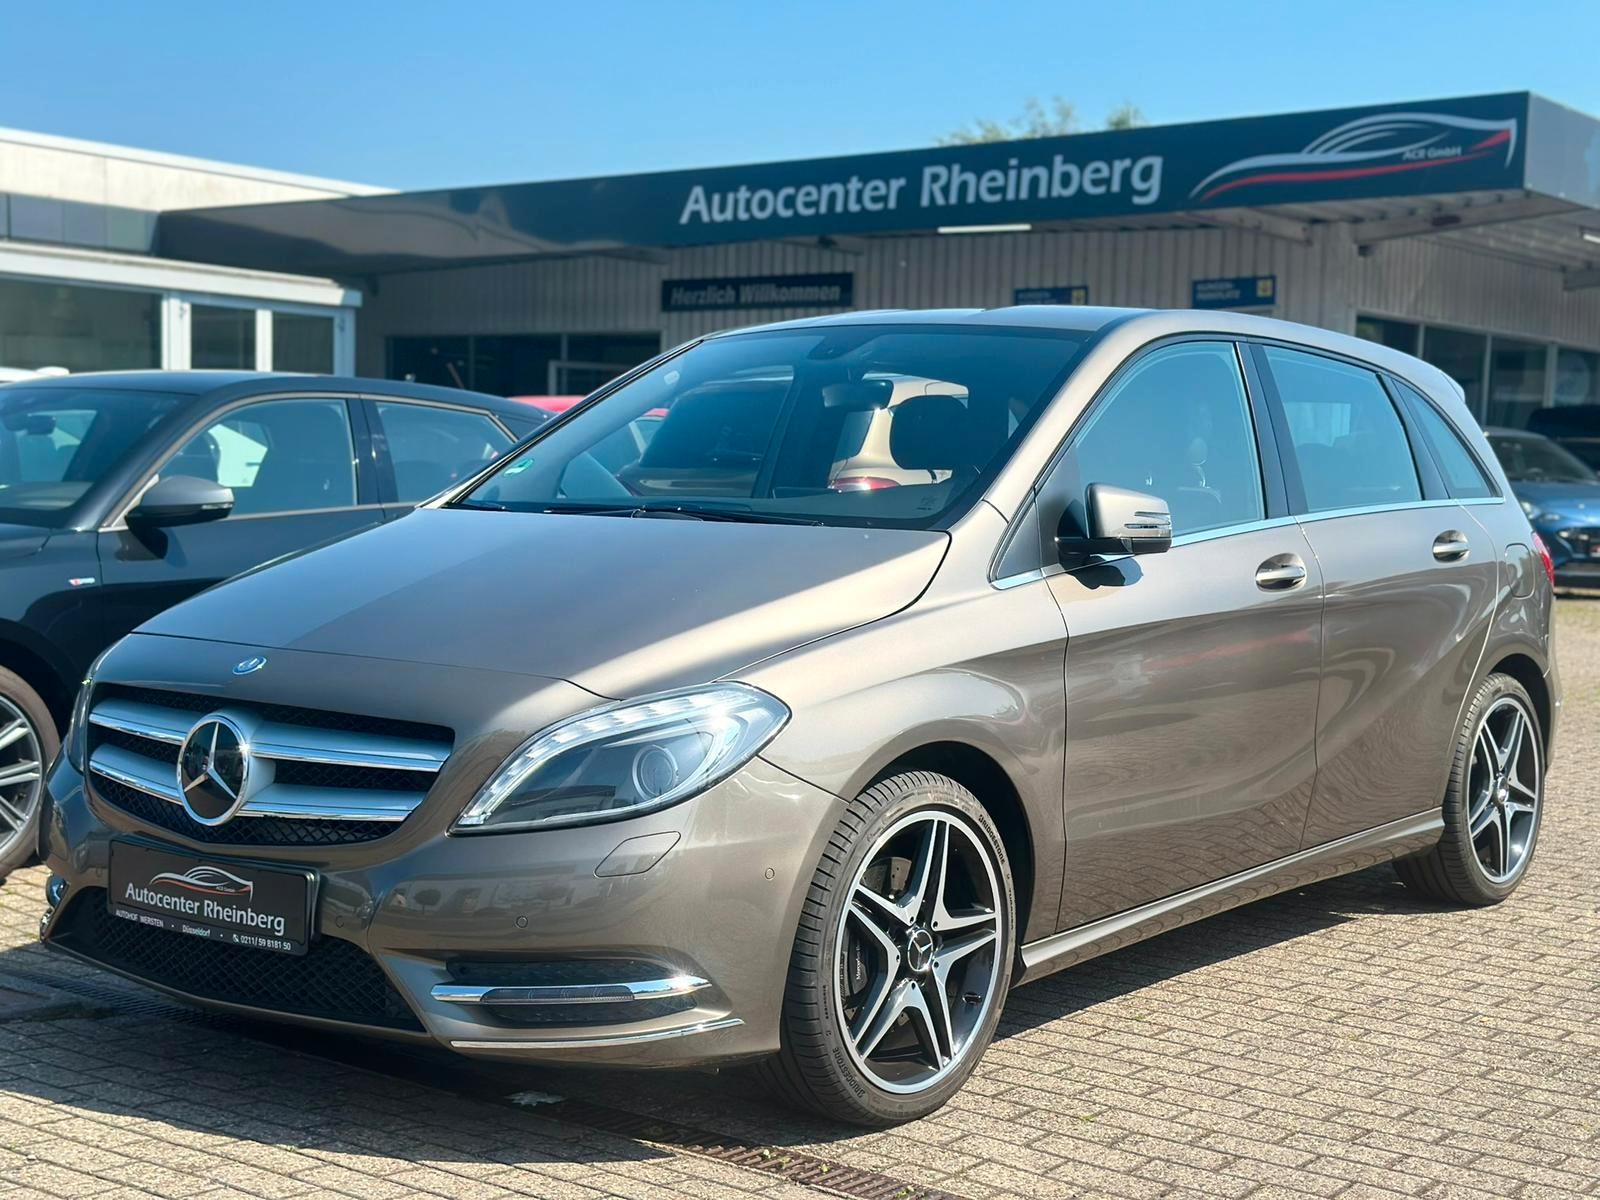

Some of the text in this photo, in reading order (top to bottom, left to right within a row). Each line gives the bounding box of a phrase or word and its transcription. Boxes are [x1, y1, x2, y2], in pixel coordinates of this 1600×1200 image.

[680, 156, 1163, 224] Autocenter Rheinberg
[671, 283, 841, 304] Herzlich Willkommen
[115, 909, 138, 921] AUTOHOF
[125, 883, 285, 936] Autocenter Rheinberg
[182, 924, 211, 937] Düsseldorf
